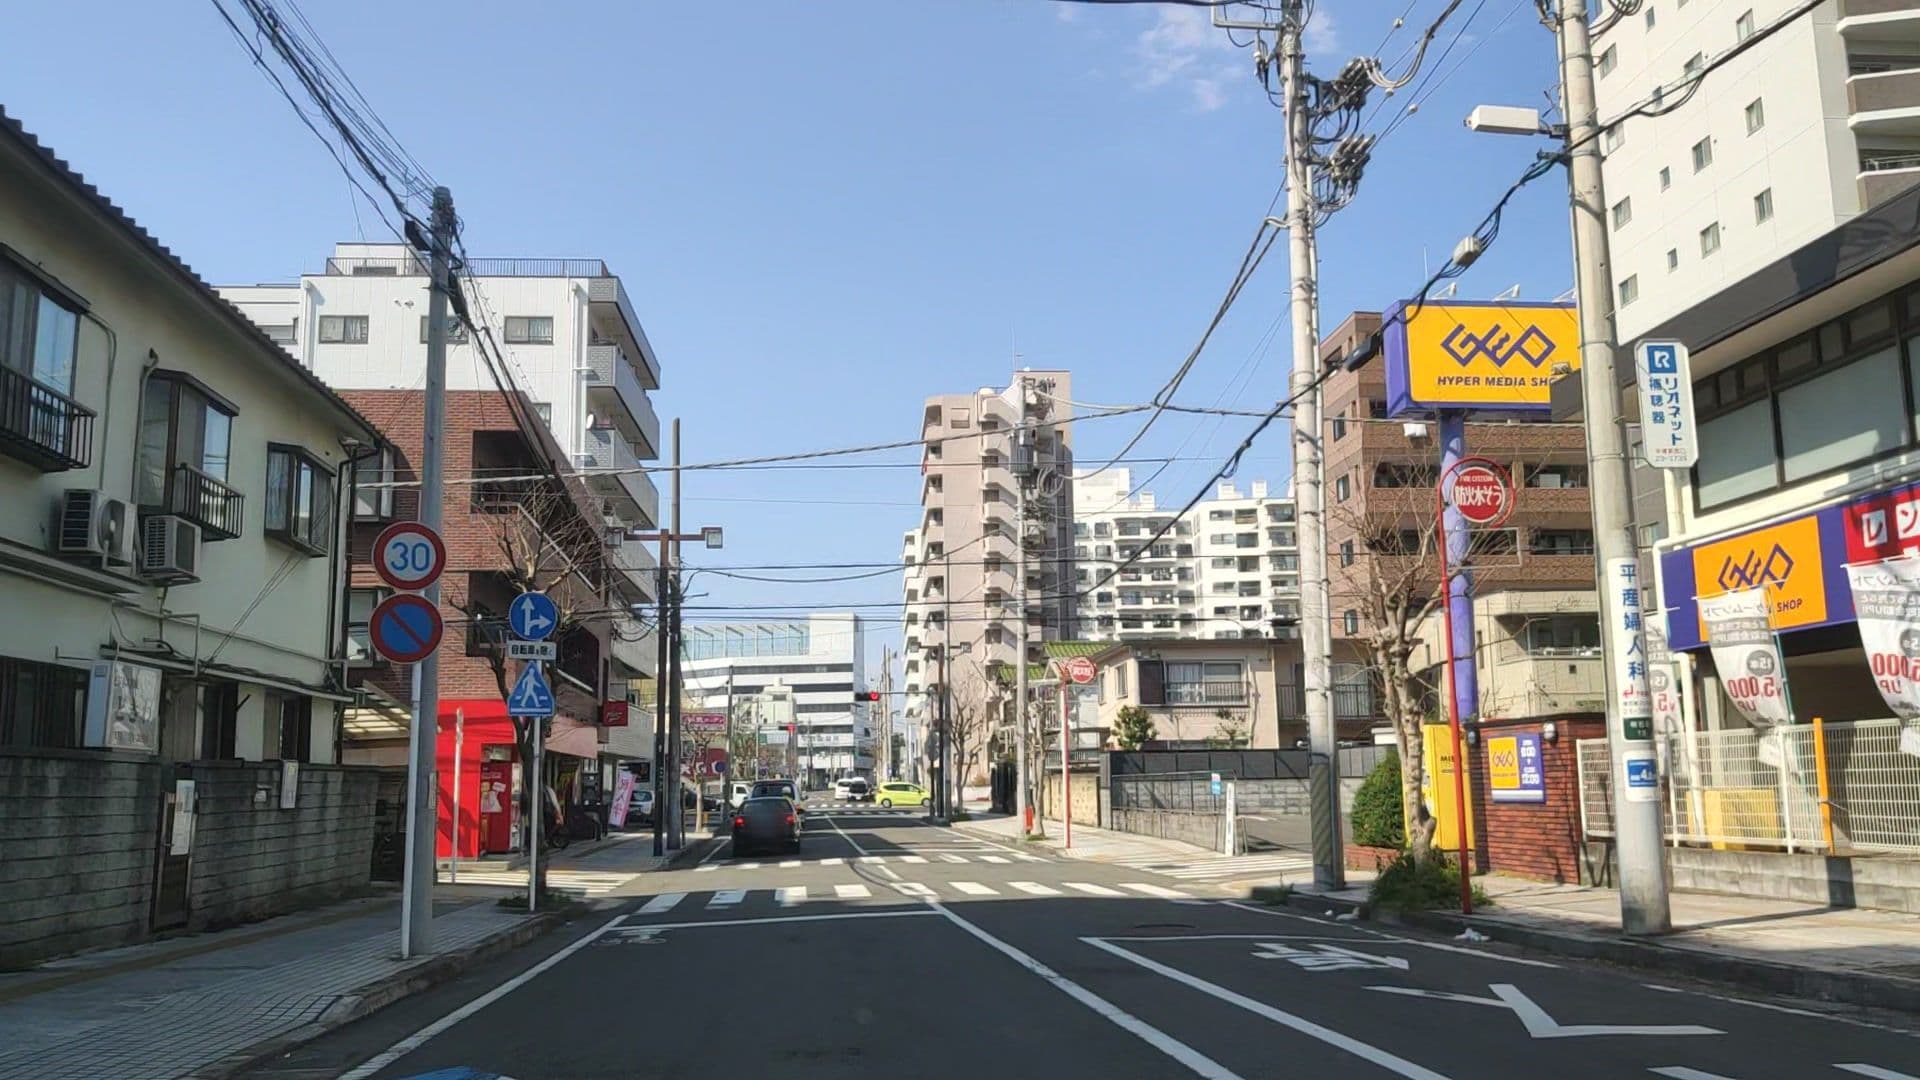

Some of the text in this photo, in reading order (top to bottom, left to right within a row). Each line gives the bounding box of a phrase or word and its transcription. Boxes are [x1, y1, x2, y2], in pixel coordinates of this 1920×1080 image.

[1440, 323, 1557, 368] GEO
[1437, 376, 1480, 386] HYPER
[1485, 376, 1526, 386] MEDIA
[1665, 377, 1683, 446] リオネット
[1454, 485, 1502, 506] 防火水そう
[391, 542, 430, 572] 30
[1776, 598, 1803, 613] SHOP
[1620, 564, 1645, 680] 平産婦人科
